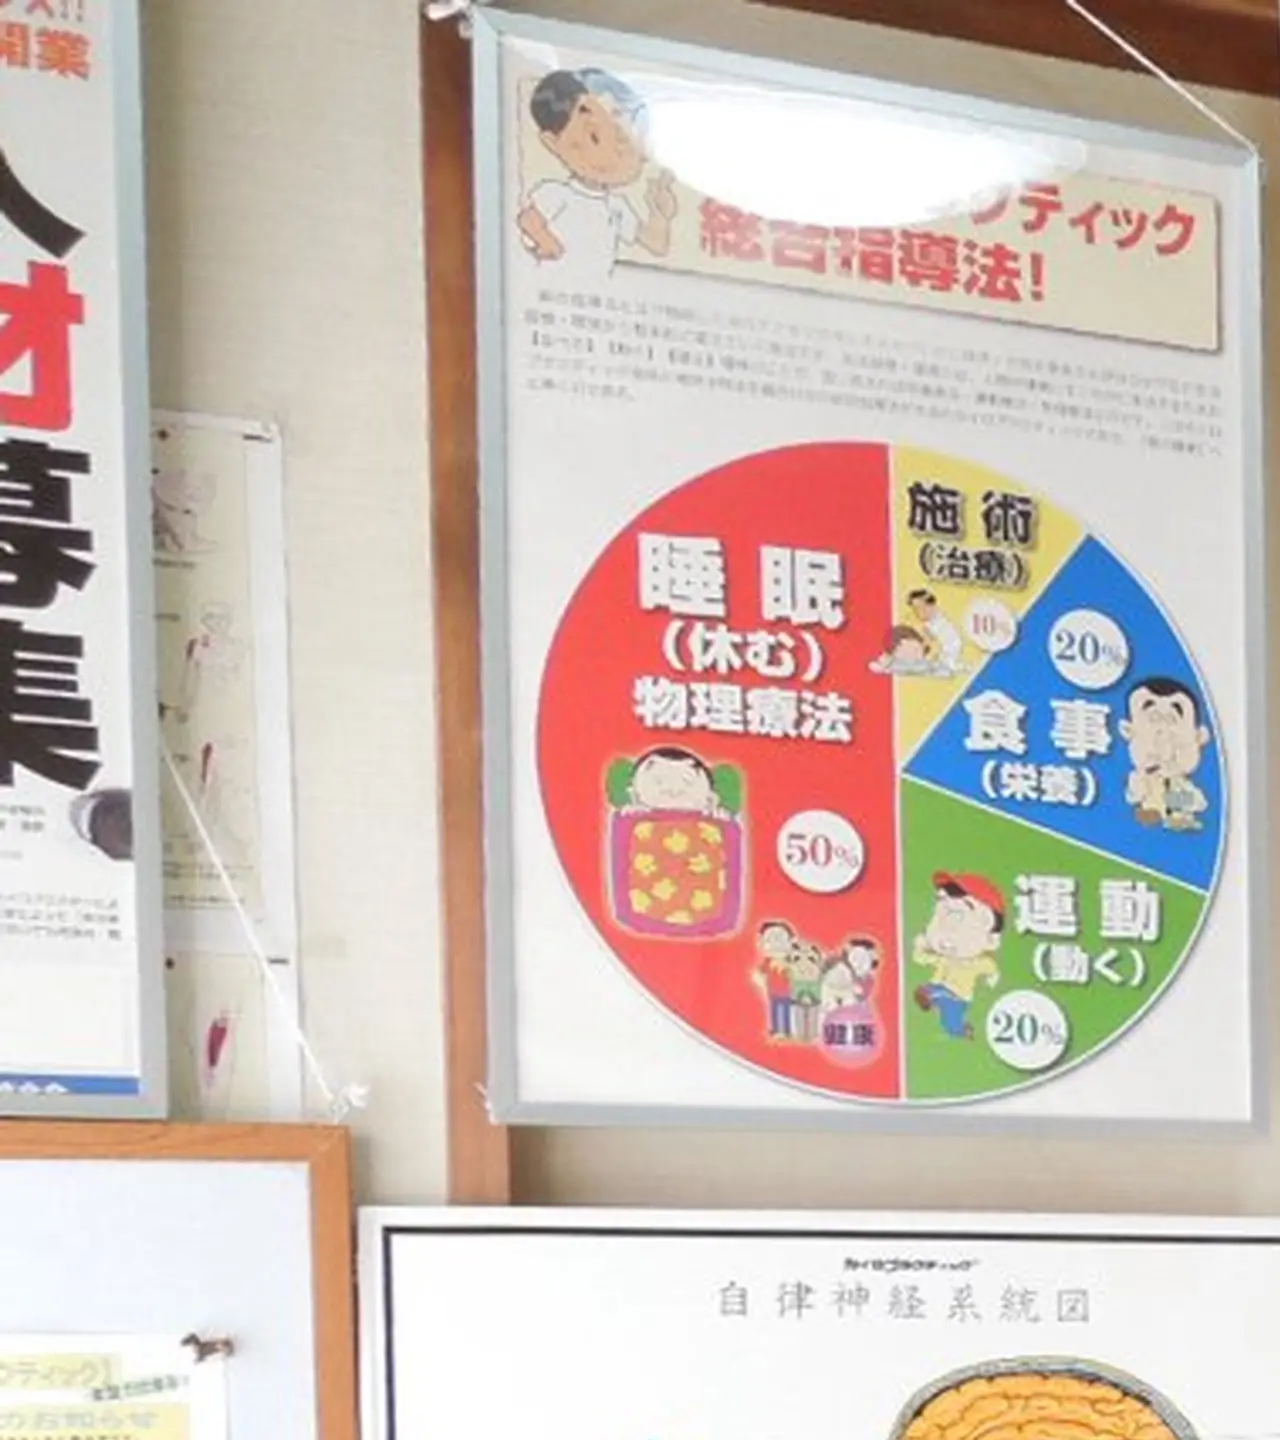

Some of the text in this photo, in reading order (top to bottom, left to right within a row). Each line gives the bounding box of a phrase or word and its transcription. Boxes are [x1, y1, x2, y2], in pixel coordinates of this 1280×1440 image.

[907, 481, 1033, 543] 施術
[638, 531, 845, 630] 睡眠
[661, 620, 823, 682] (休む)
[1054, 629, 1127, 668] 20%
[632, 674, 853, 742] 物理療法
[963, 690, 1112, 758] 食事
[785, 832, 859, 869] 50%
[1013, 874, 1160, 942] 運動
[1033, 941, 1146, 987] (動く)
[992, 1012, 1065, 1047] 20%
[718, 1281, 1091, 1325] 自律神経系統図
